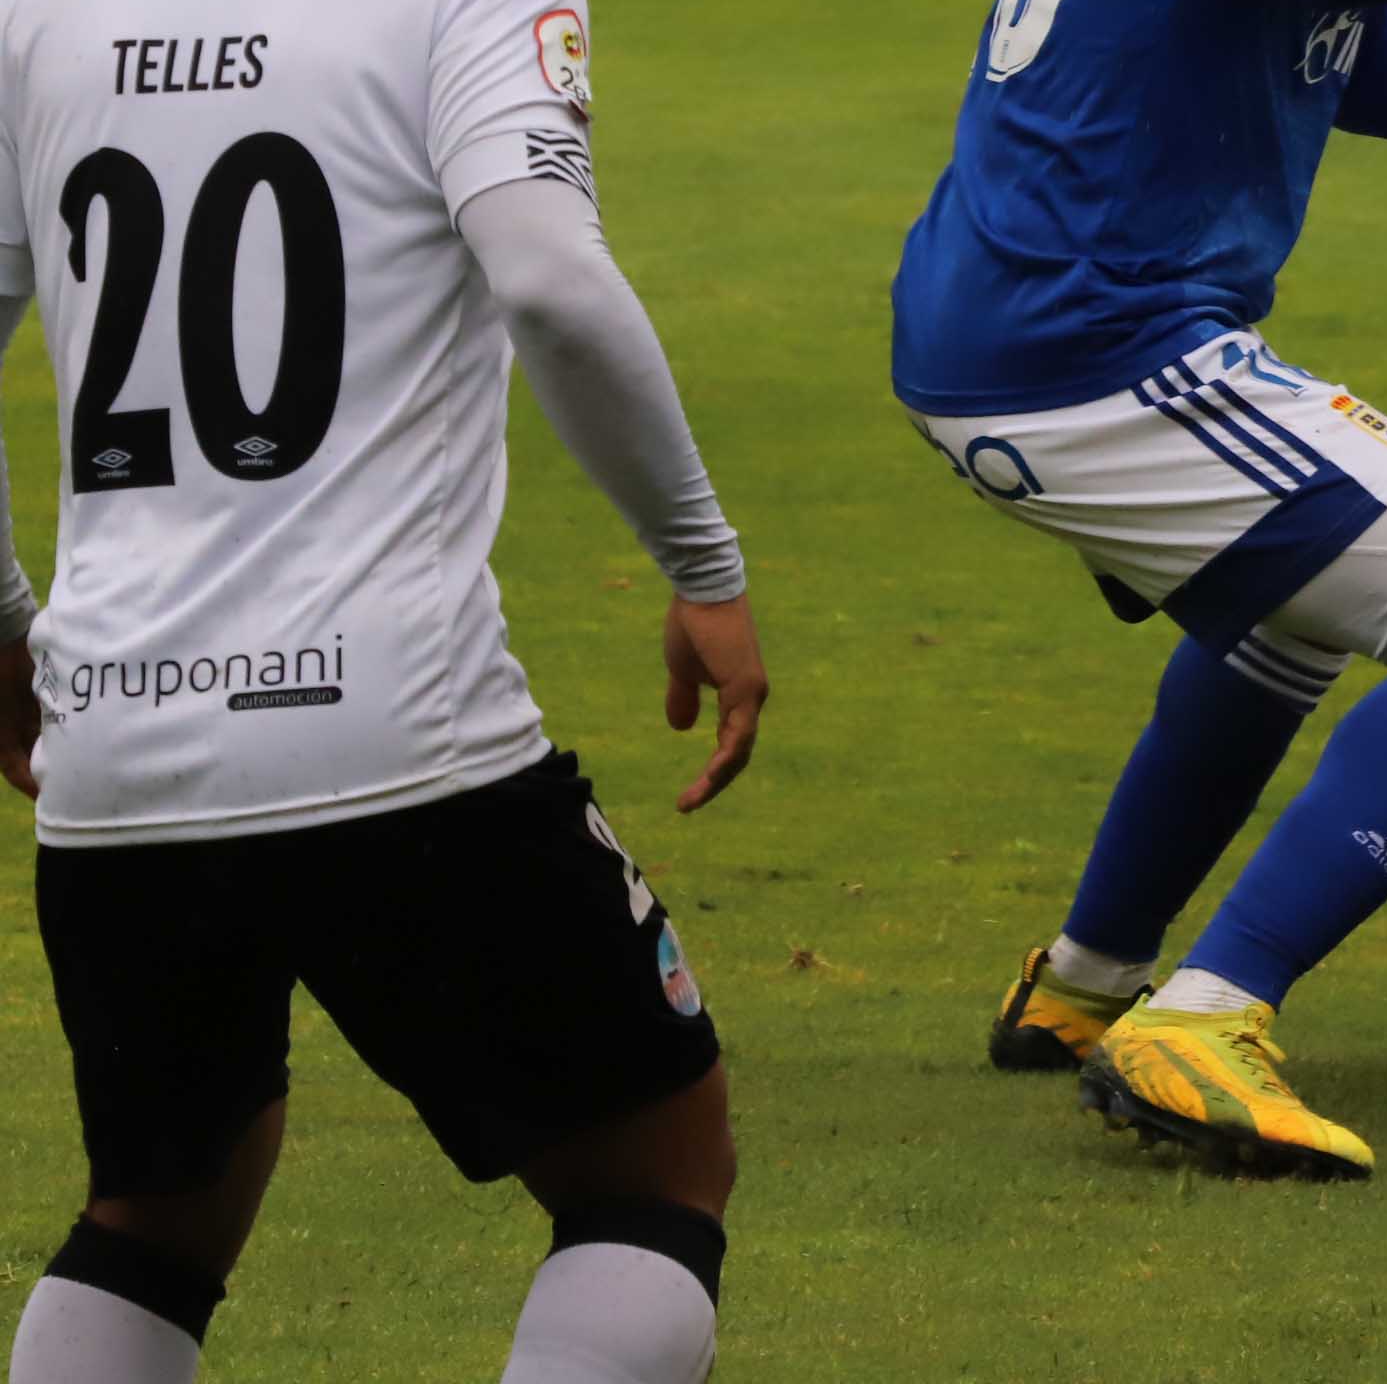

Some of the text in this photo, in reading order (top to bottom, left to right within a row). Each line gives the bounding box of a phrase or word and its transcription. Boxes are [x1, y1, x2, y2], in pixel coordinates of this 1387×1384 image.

[112, 34, 268, 95] TELLES
[59, 131, 346, 494] 20
[70, 634, 343, 711] gruponani
[234, 688, 333, 709] automoción
